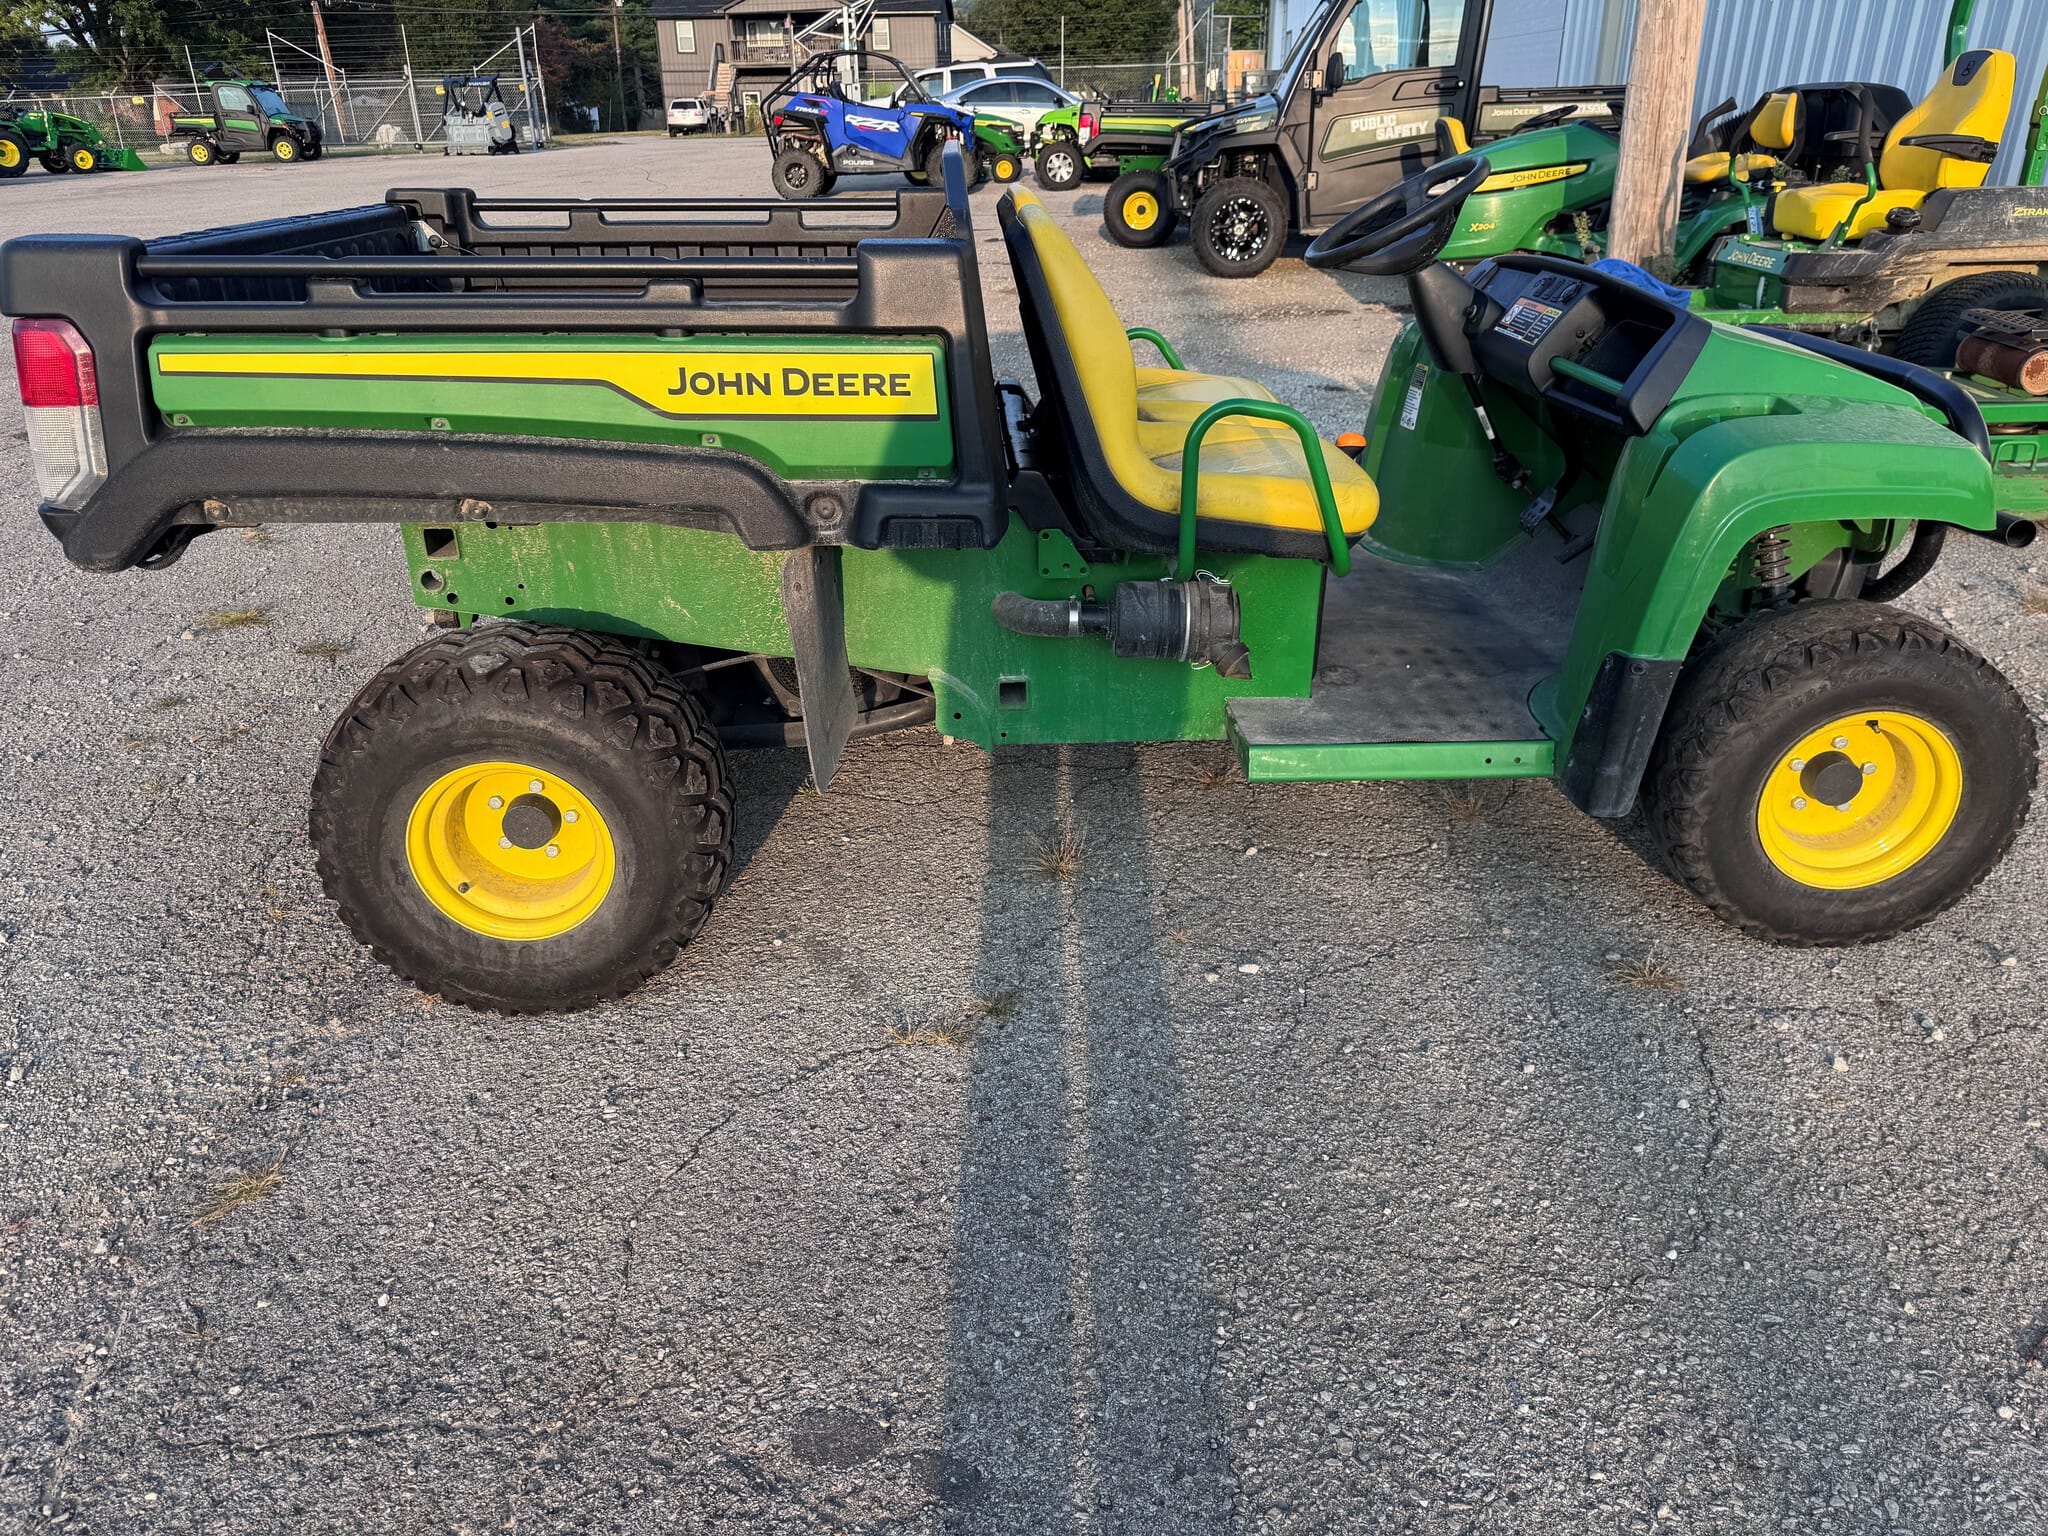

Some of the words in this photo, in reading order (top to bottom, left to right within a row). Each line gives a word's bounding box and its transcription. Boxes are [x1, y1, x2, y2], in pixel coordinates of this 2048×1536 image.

[794, 105, 819, 115] TRAIL
[1490, 108, 1512, 117] JOHN
[1513, 107, 1540, 116] DEERE
[845, 114, 900, 133] RZR
[1350, 114, 1397, 133] PUBLIC
[1376, 120, 1429, 140] SAFETY
[1510, 172, 1538, 184] JOHN
[1538, 167, 1572, 179] DEERE
[1727, 249, 1750, 263] JOHN
[1748, 251, 1777, 268] DEERE
[668, 367, 771, 396] JOHN
[782, 367, 911, 397] DEERE
